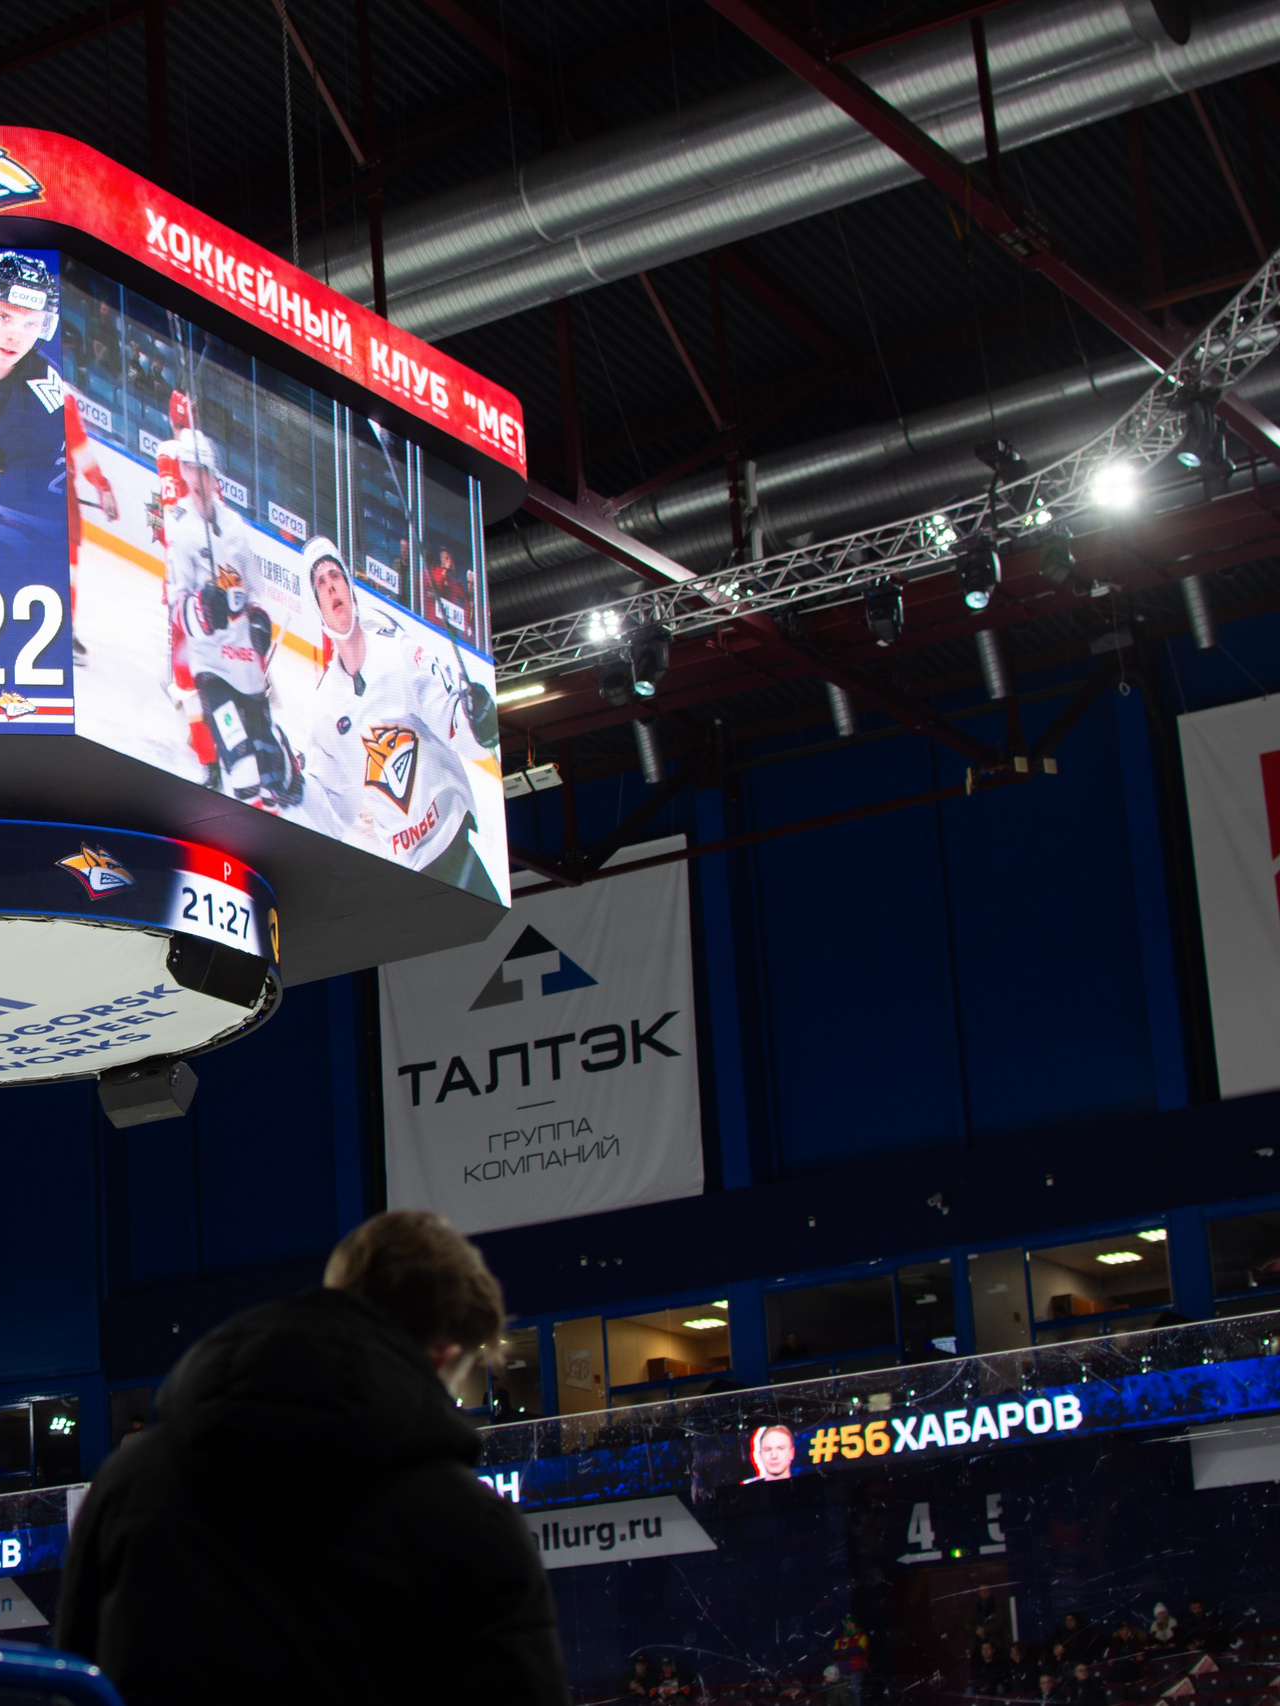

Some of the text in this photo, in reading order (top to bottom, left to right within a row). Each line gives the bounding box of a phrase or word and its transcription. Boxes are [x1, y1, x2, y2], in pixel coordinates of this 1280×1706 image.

[21, 269, 40, 283] 22
[145, 208, 353, 357] ХОККЕЙНЫЙ
[370, 336, 449, 410] КЛУБ
[271, 506, 304, 534] согаз
[392, 798, 440, 855] FONBET
[181, 887, 251, 940] 21:27
[6, 1045, 49, 1056] &
[45, 1010, 178, 1047] STEEL
[397, 1010, 683, 1108] ТАЛТЭК
[463, 1134, 621, 1185] КОМПАНИЙ
[488, 1116, 594, 1154] ГРУППА
[907, 1502, 936, 1550] 4
